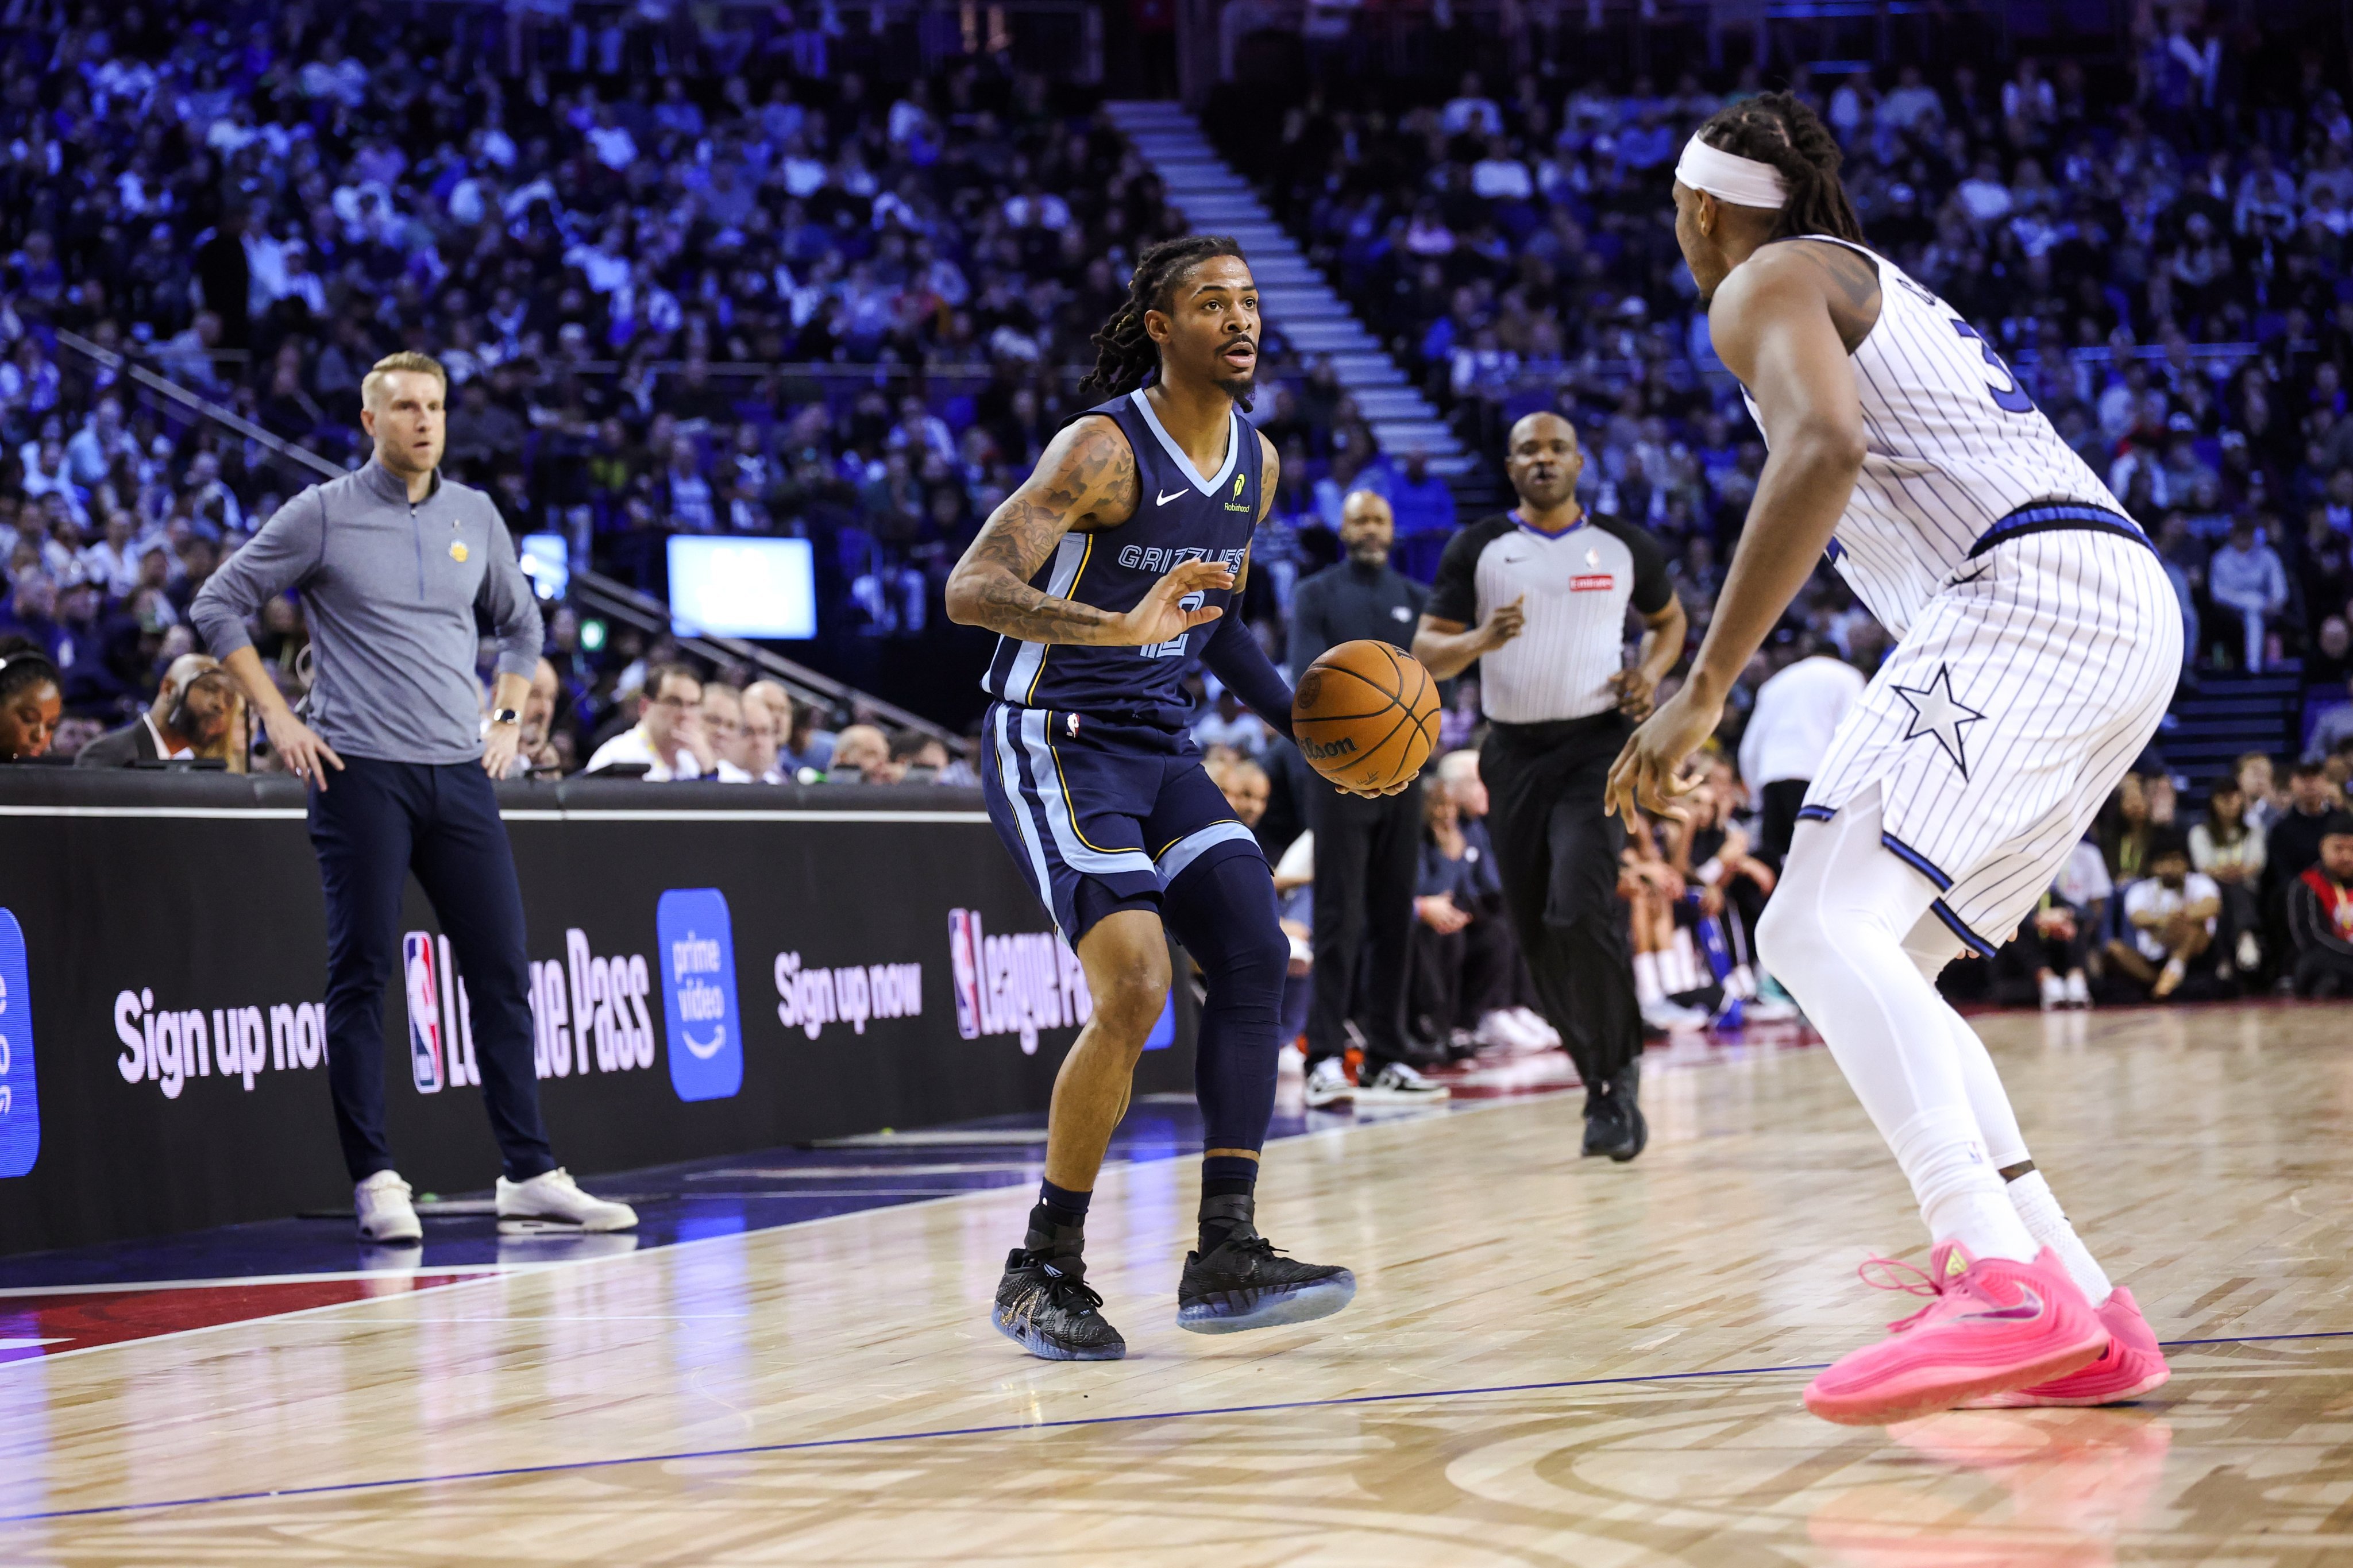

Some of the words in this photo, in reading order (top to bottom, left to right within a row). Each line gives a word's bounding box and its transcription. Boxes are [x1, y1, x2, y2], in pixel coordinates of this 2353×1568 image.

[1224, 503, 1250, 513] Robinhood
[1140, 590, 1205, 659] 2
[672, 929, 722, 984] prime
[774, 950, 838, 1041] Sign
[834, 965, 871, 1035] up
[868, 963, 923, 1019] now
[970, 909, 1063, 1056] League
[1054, 933, 1093, 1028] Pa
[566, 927, 655, 1075] Pass
[677, 977, 726, 1022] video
[114, 987, 210, 1099] Sign
[213, 1006, 267, 1091] up
